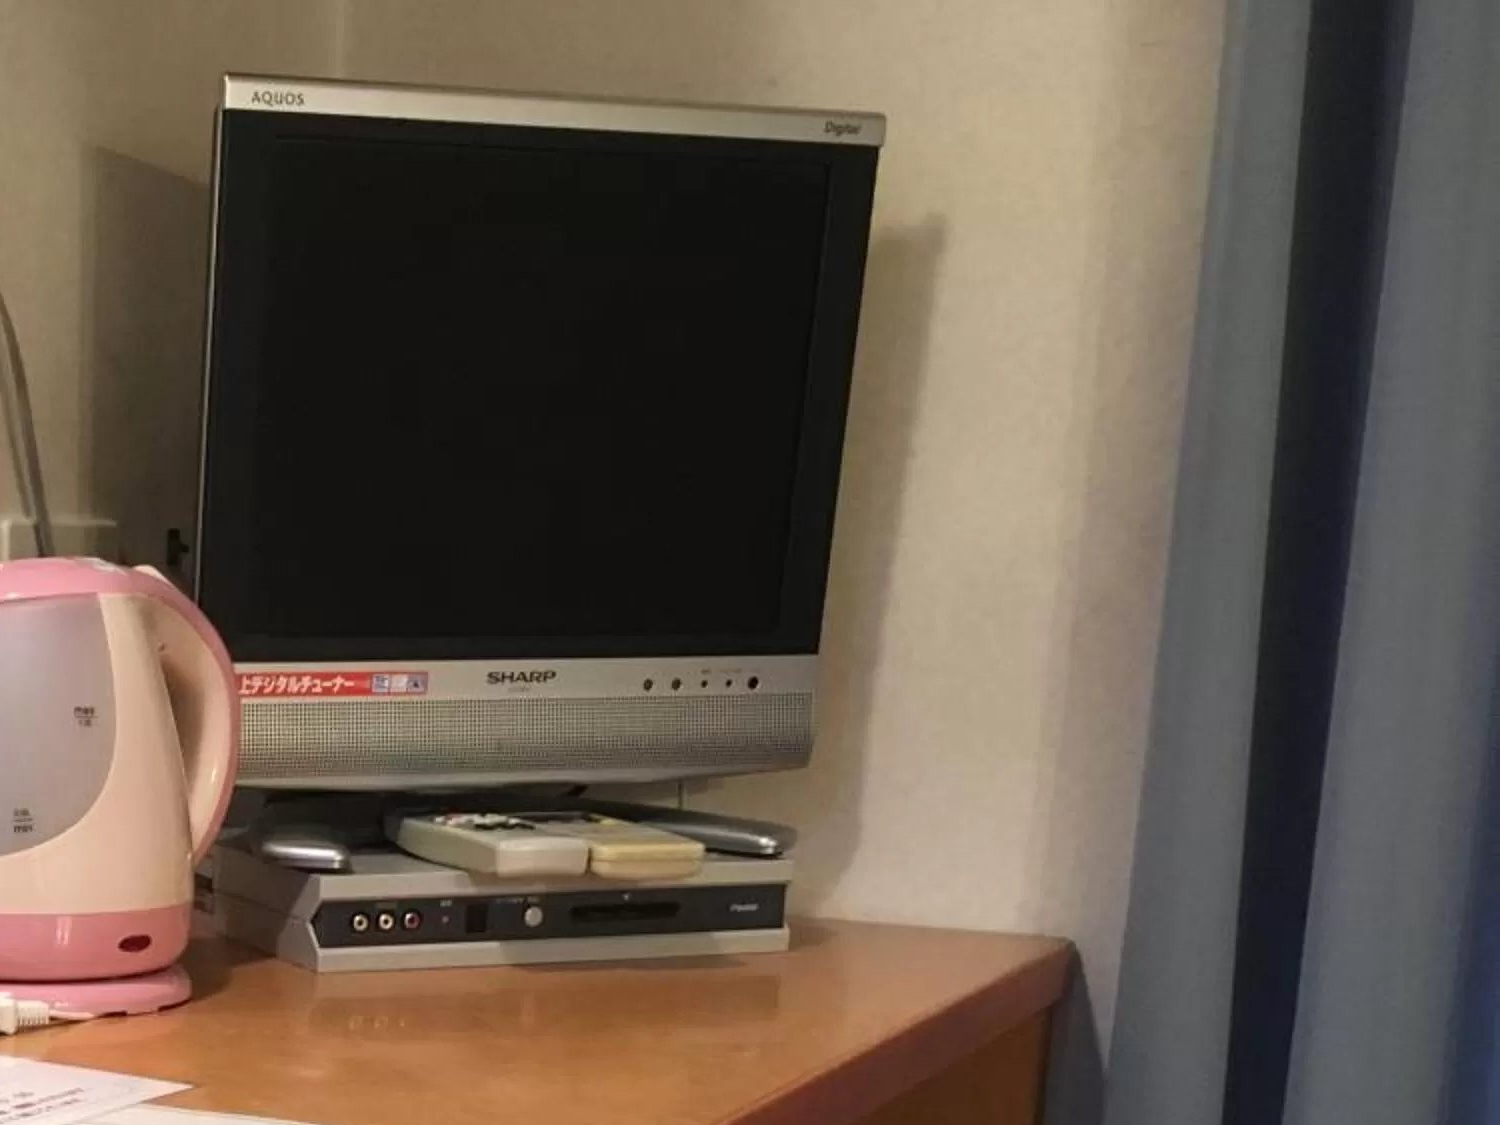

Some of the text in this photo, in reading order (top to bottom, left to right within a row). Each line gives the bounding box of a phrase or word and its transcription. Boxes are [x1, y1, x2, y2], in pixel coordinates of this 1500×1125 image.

[251, 90, 305, 108] AQUOS
[238, 674, 355, 695] 上デジタルチューナー
[486, 670, 557, 685] SHARP
